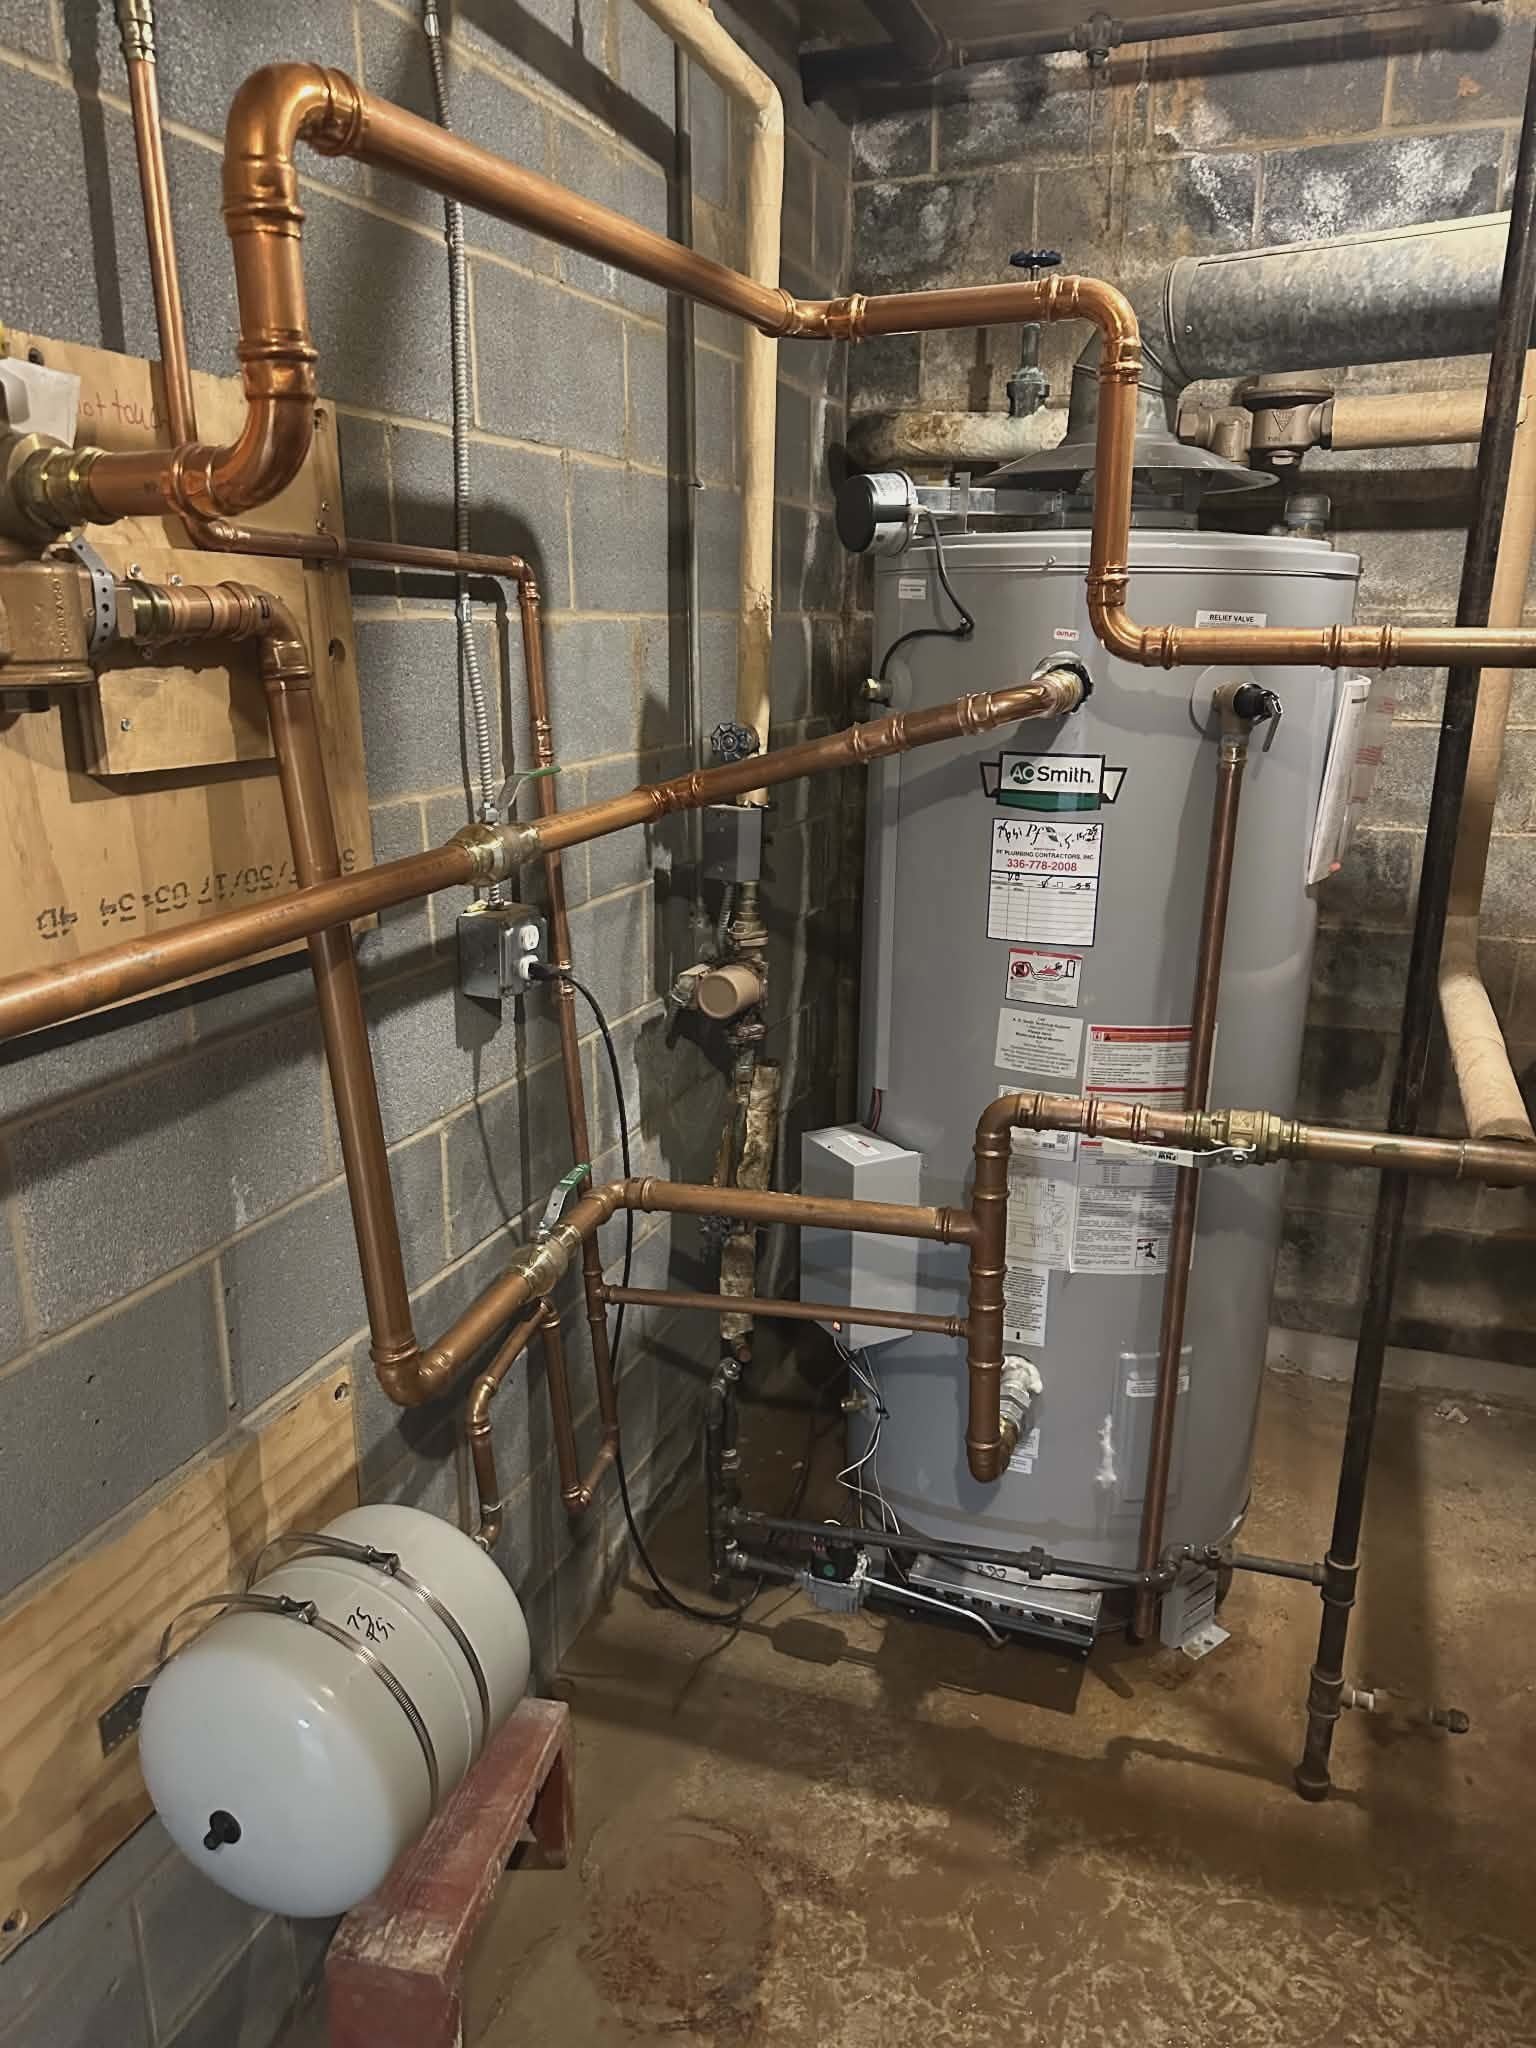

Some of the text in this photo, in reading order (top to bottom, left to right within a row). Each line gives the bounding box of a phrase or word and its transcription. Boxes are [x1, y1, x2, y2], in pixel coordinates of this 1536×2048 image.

[1209, 614, 1233, 622] RELIEF
[1037, 765, 1094, 785] Smith
[1035, 852, 1081, 860] CONTRACTORS,
[1007, 858, 1077, 872] 336-778-2008
